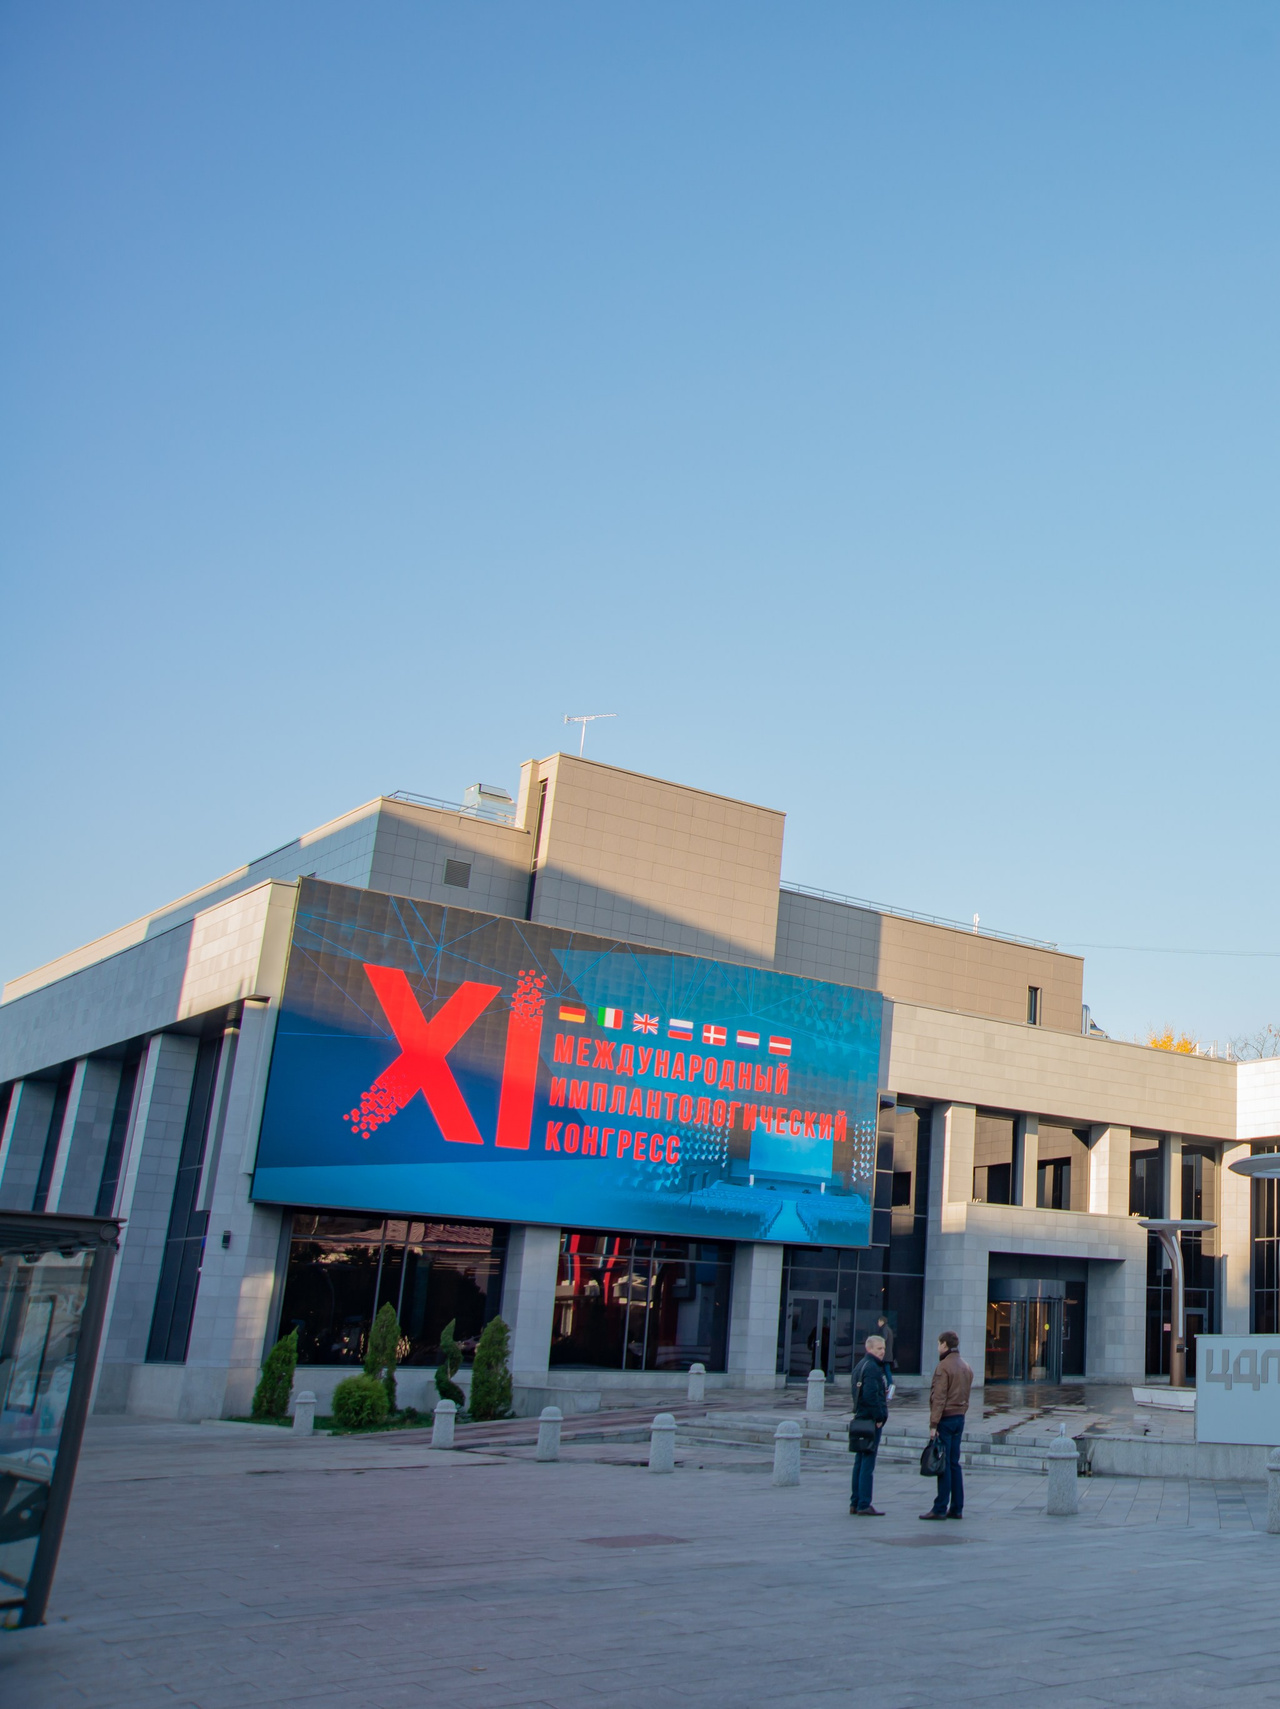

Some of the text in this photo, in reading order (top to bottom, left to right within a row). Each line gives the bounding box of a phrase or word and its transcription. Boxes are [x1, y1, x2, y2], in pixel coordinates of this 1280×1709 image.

[346, 963, 546, 1151] XI
[552, 1033, 791, 1096] МЕЖДУНАРОДНЫЙ
[549, 1076, 848, 1142] ИМПЛАНТОЛОГИЧЕСКИЙ
[544, 1121, 681, 1165] КОНГРЕСС
